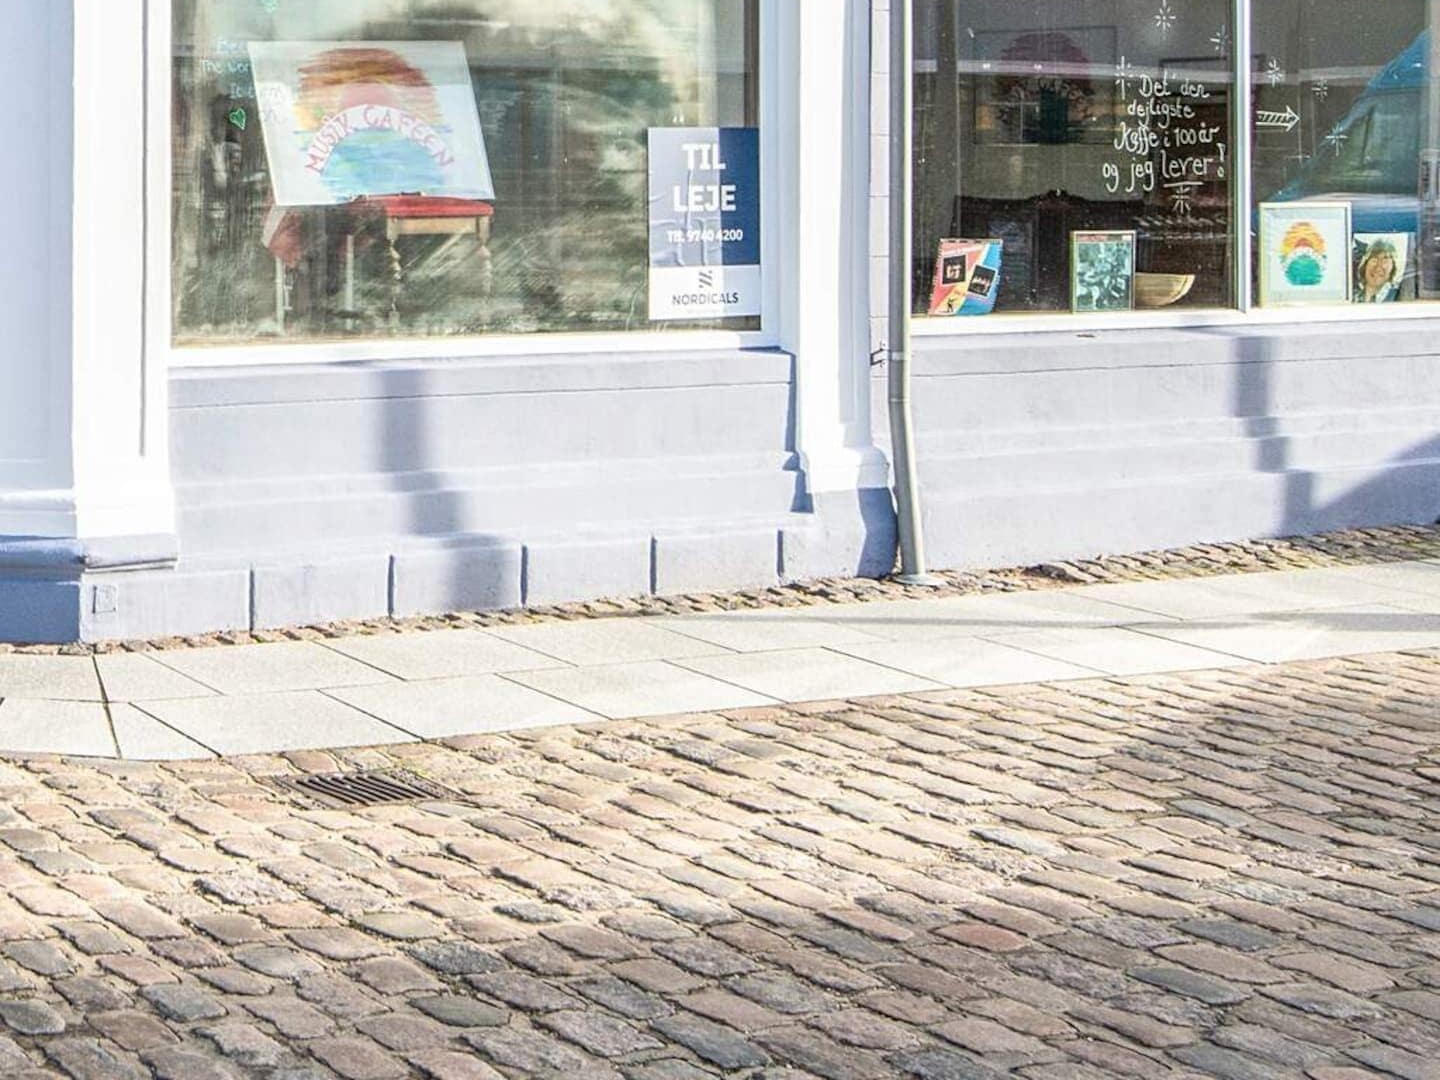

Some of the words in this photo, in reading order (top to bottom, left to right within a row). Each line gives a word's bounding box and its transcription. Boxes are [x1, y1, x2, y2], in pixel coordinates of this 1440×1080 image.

[1180, 78, 1210, 98] den
[1127, 97, 1196, 129] dejligste
[1163, 131, 1171, 147] i
[1173, 127, 1197, 147] 100
[1198, 121, 1220, 143] år
[681, 143, 727, 170] TIL
[1102, 162, 1120, 193] og
[1125, 156, 1154, 193] jeg
[672, 184, 737, 212] LEJE
[716, 228, 744, 241] 4200
[672, 291, 739, 305] NORDICALS
